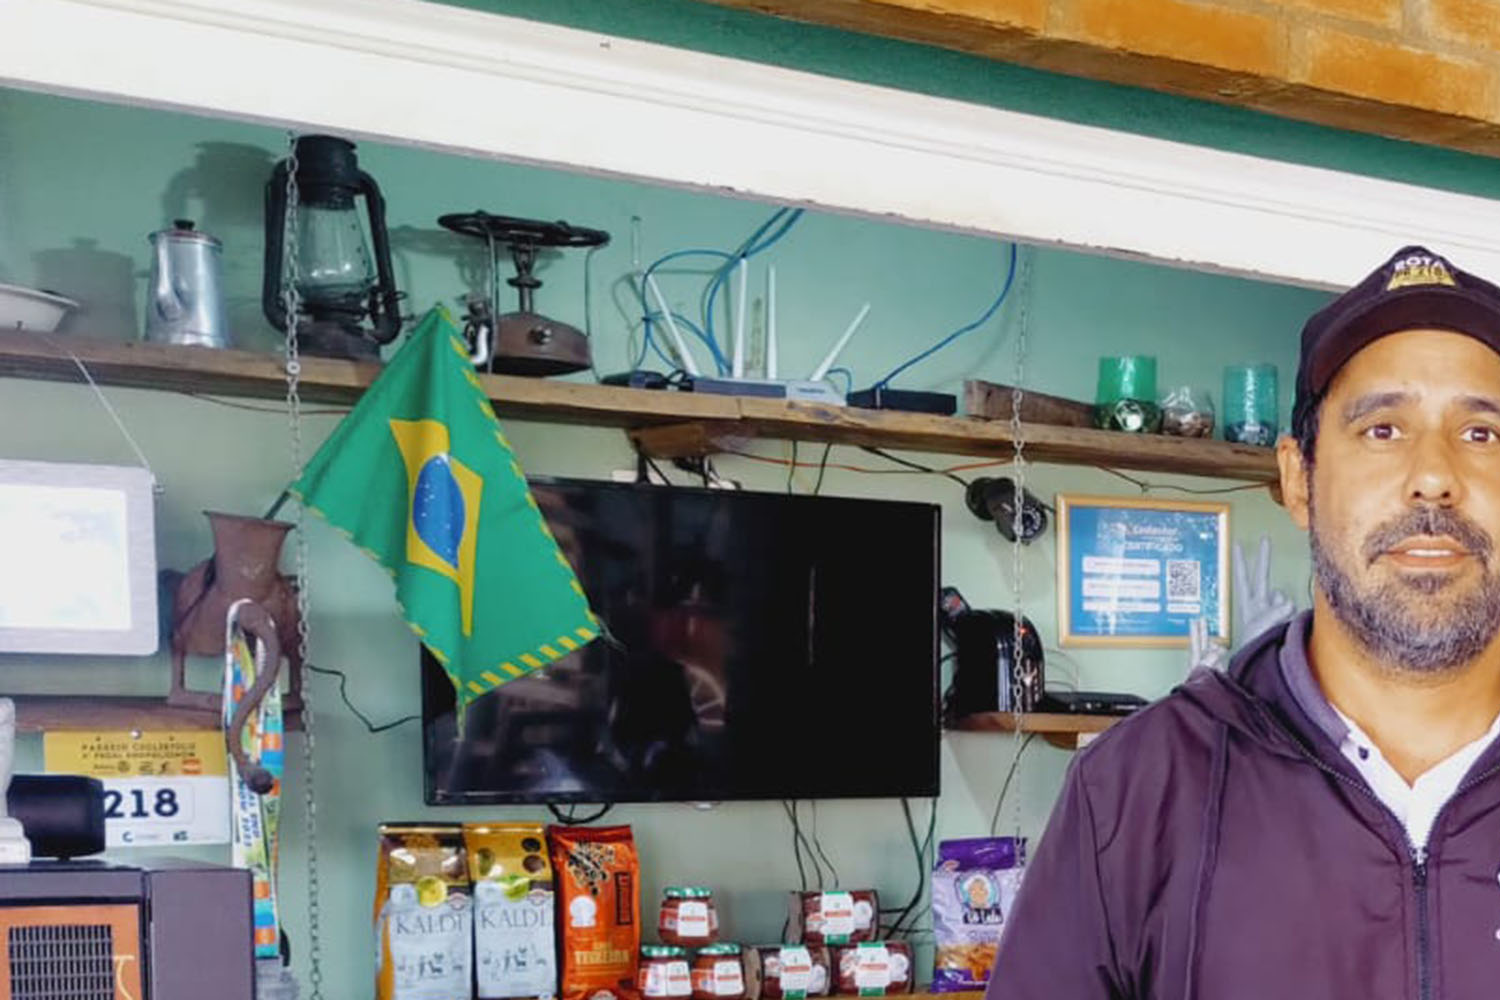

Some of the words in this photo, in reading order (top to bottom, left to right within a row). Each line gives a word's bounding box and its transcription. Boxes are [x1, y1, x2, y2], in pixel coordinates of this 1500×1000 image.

[1394, 256, 1445, 272] ROTA
[103, 788, 179, 819] 218
[396, 912, 464, 936] KALDI
[480, 909, 546, 931] KALDI
